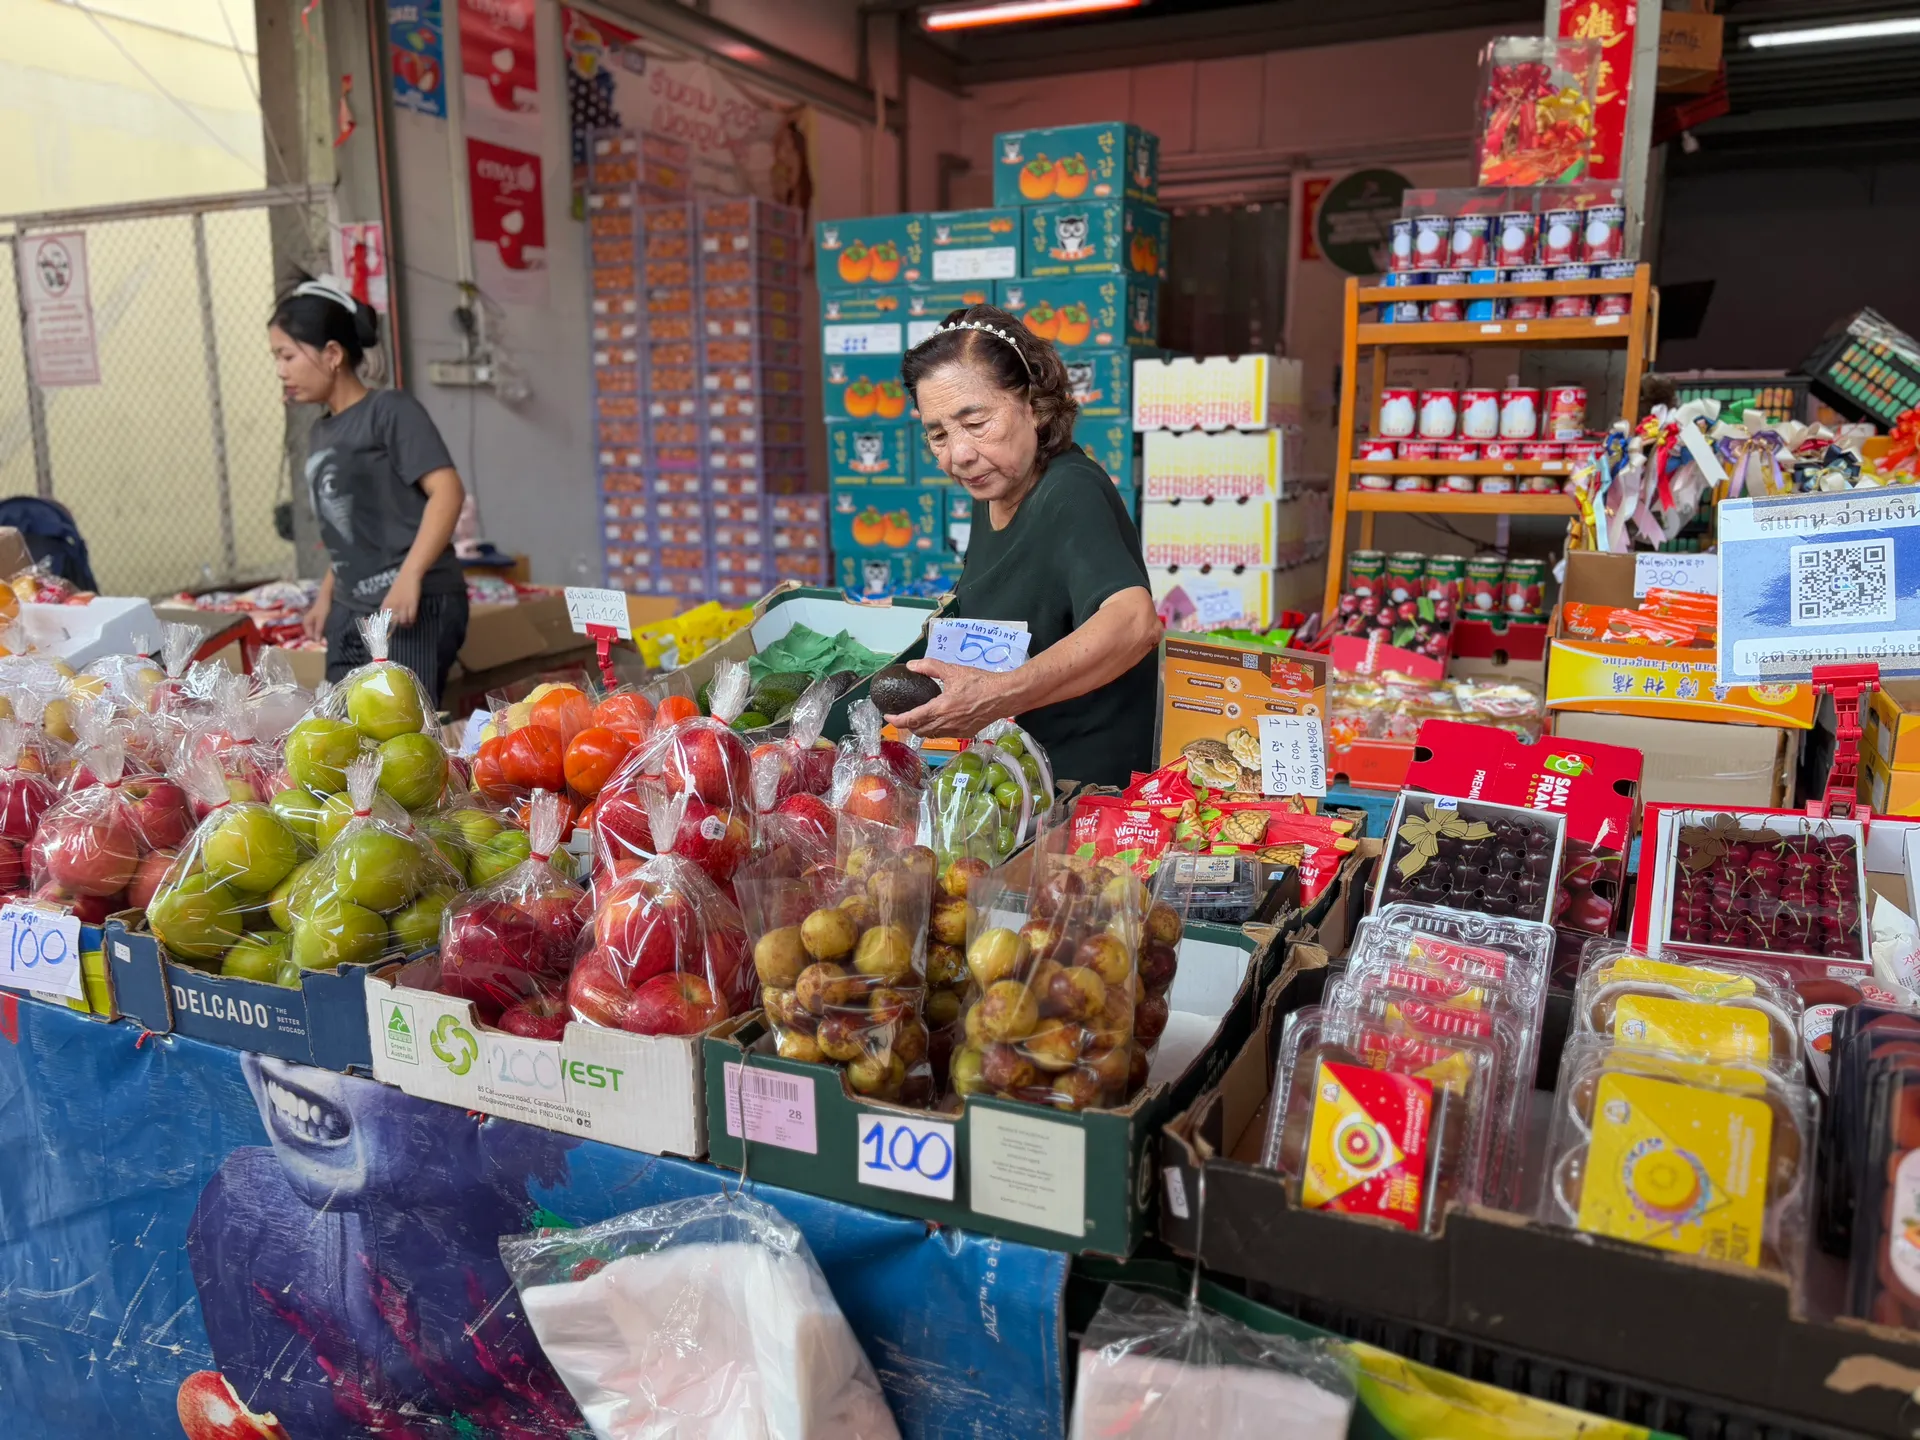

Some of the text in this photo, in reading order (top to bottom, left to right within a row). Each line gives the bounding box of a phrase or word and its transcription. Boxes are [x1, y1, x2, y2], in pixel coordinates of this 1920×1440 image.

[1760, 512, 1829, 532] สแกน
[955, 632, 1012, 664] 50
[1745, 647, 1848, 665] เนตรชนก
[1602, 656, 1668, 672] Tangerine
[1671, 662, 1691, 673] Wo
[1292, 765, 1306, 785] 35
[1551, 777, 1572, 808] SAN
[1115, 826, 1160, 838] Walnut
[1117, 835, 1158, 846] Easy Peel
[11, 922, 67, 972] 100
[276, 1007, 288, 1015] THE
[277, 1016, 300, 1026] BETTER
[278, 1025, 306, 1036] AVOCADO
[391, 1042, 407, 1051] Grown
[391, 1050, 413, 1061] Australia
[493, 1043, 557, 1090] 200
[478, 1094, 573, 1123] info@avowest.com.au FIND US ON
[533, 1098, 566, 1112] Carabooda
[565, 1106, 576, 1114] WA
[576, 1109, 591, 1119] 6033
[788, 1109, 802, 1121] 28
[862, 1121, 953, 1181] 100
[1402, 1172, 1420, 1214] FRUIT
[982, 1271, 996, 1285] is
